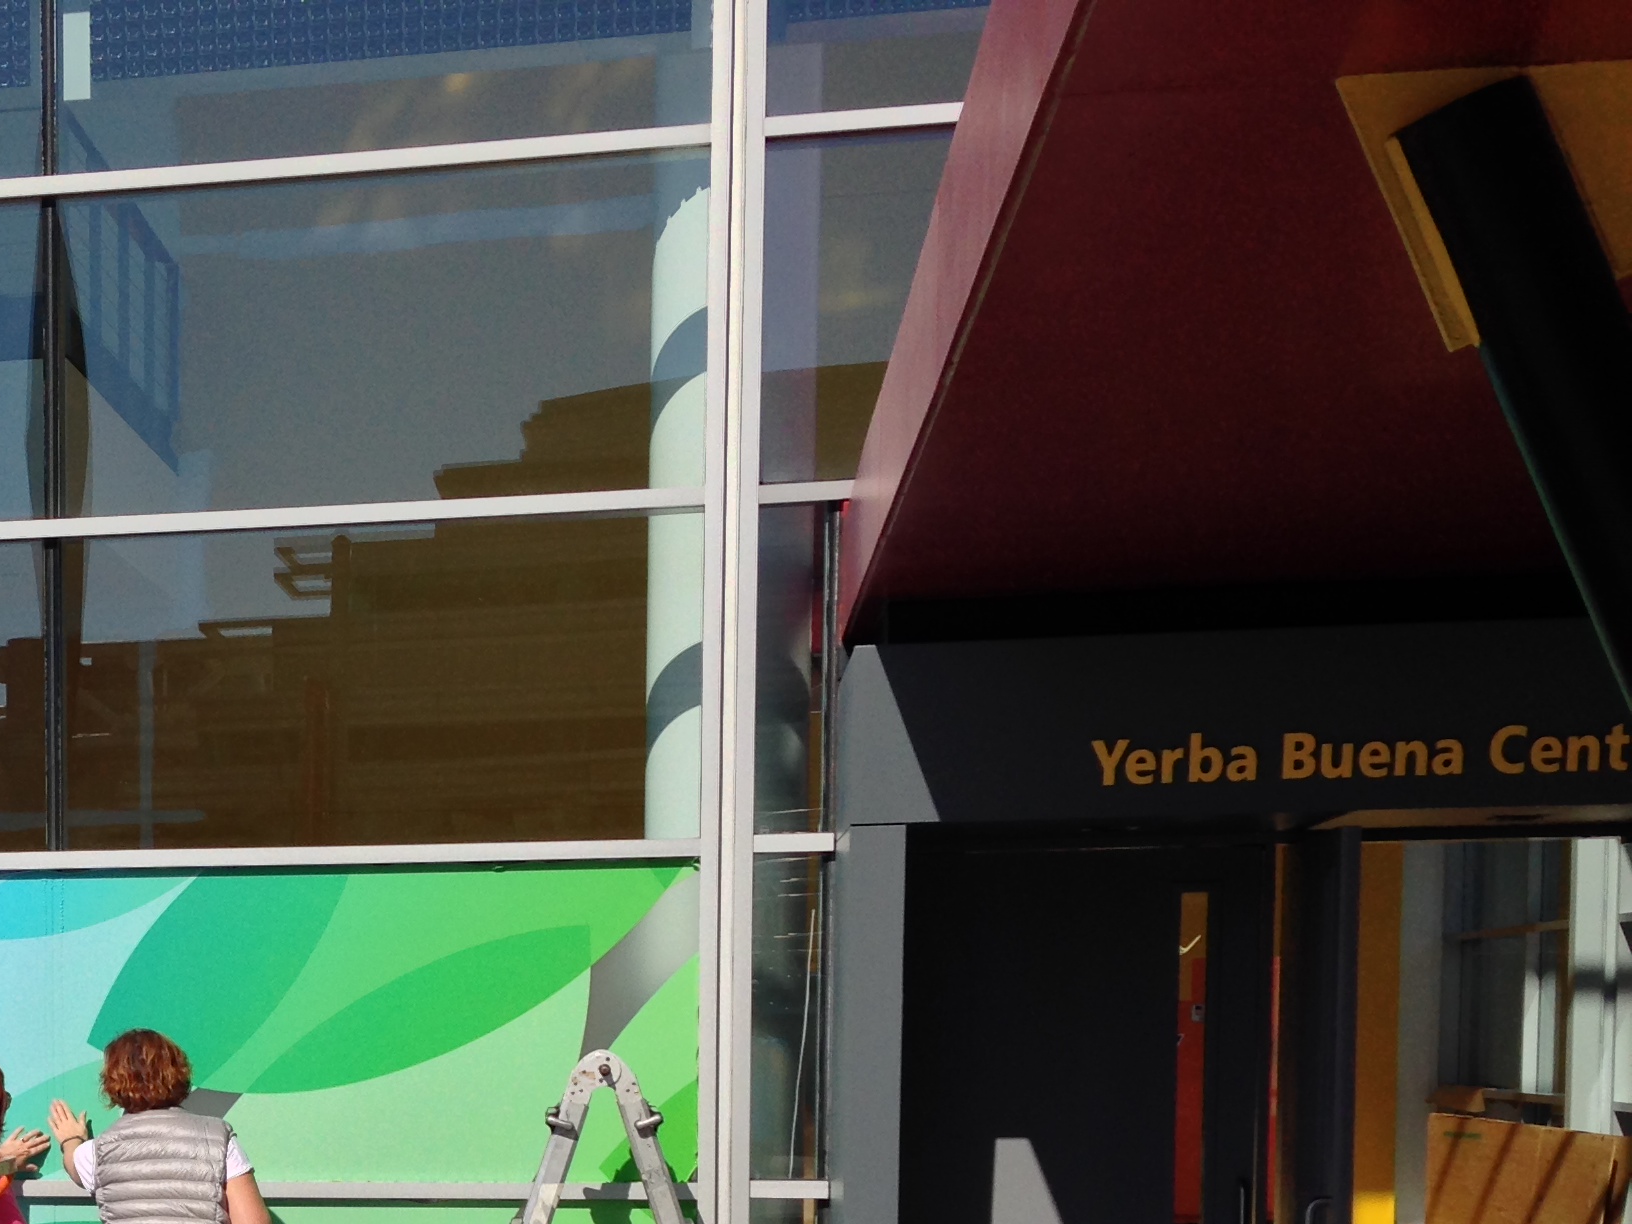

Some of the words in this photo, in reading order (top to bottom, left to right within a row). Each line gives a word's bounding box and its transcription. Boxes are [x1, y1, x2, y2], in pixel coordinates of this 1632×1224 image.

[1092, 733, 1258, 786] Yerba
[1281, 731, 1466, 781] Buena
[1489, 724, 1632, 774] Cent
